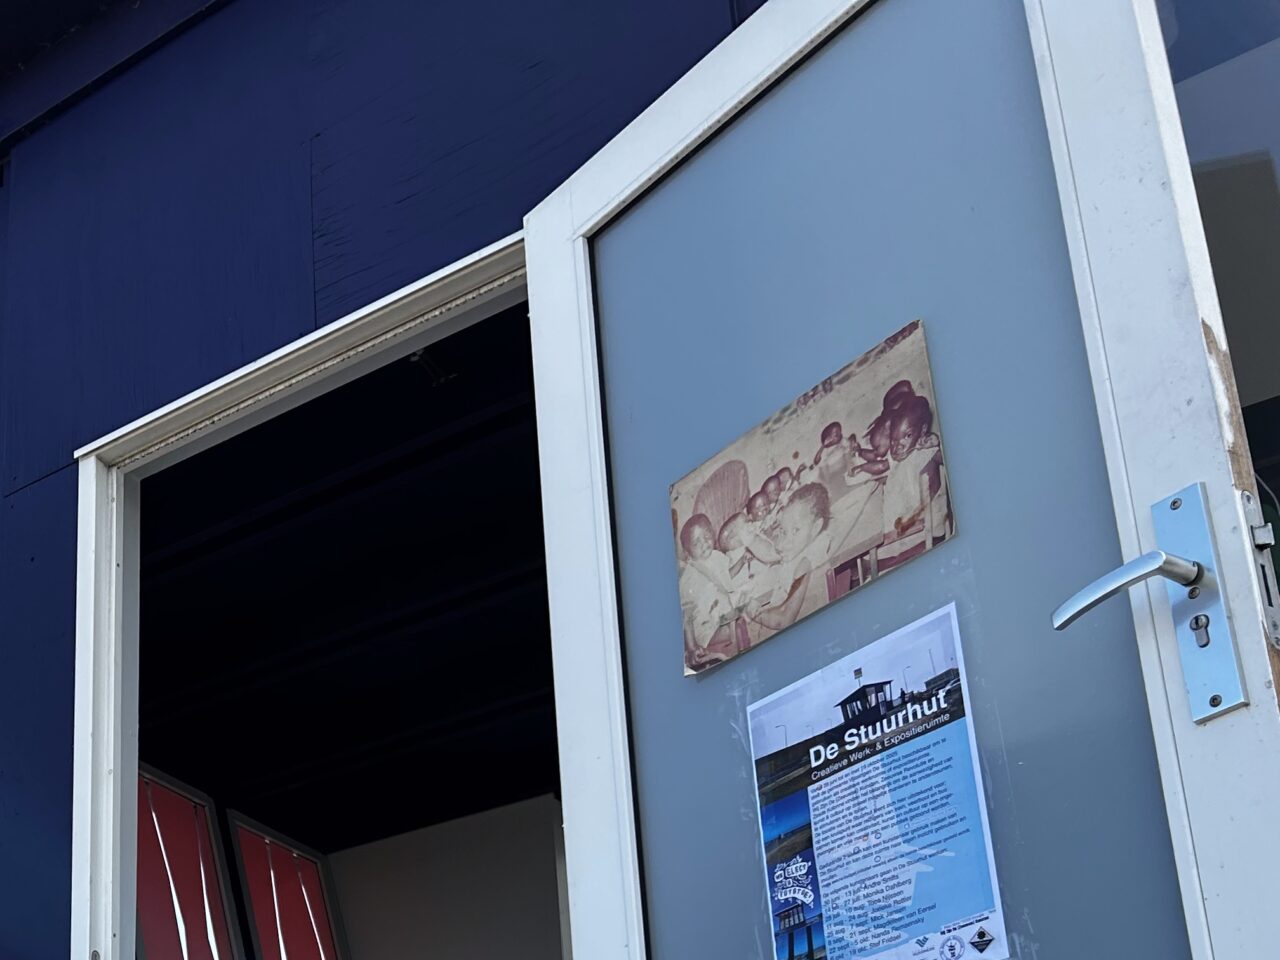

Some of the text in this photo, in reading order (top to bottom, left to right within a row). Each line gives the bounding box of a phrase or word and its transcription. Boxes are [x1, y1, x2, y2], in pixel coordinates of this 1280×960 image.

[810, 691, 948, 768] De Stuurhut
[811, 712, 950, 781] Creatieve Werk- & Expositieruimte
